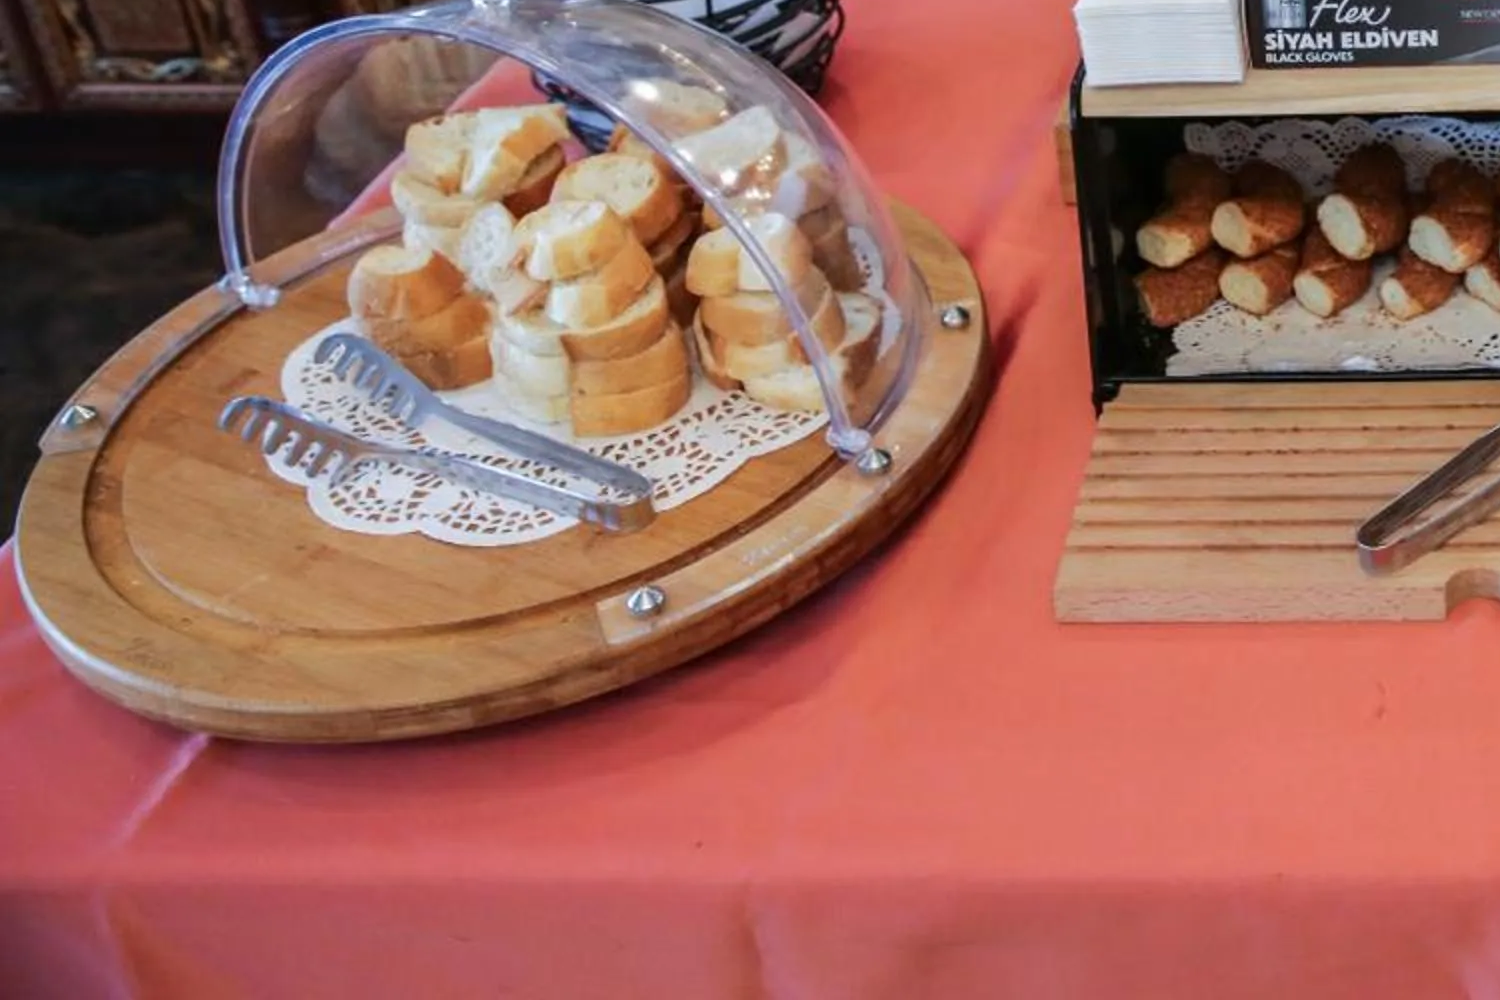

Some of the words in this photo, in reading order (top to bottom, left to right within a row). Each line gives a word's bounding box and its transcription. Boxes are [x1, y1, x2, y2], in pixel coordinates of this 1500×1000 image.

[1264, 29, 1333, 51] SİYAH
[1341, 26, 1439, 49] ELDİVEN
[1265, 52, 1303, 64] BLACK
[1305, 51, 1355, 63] GLOVES
